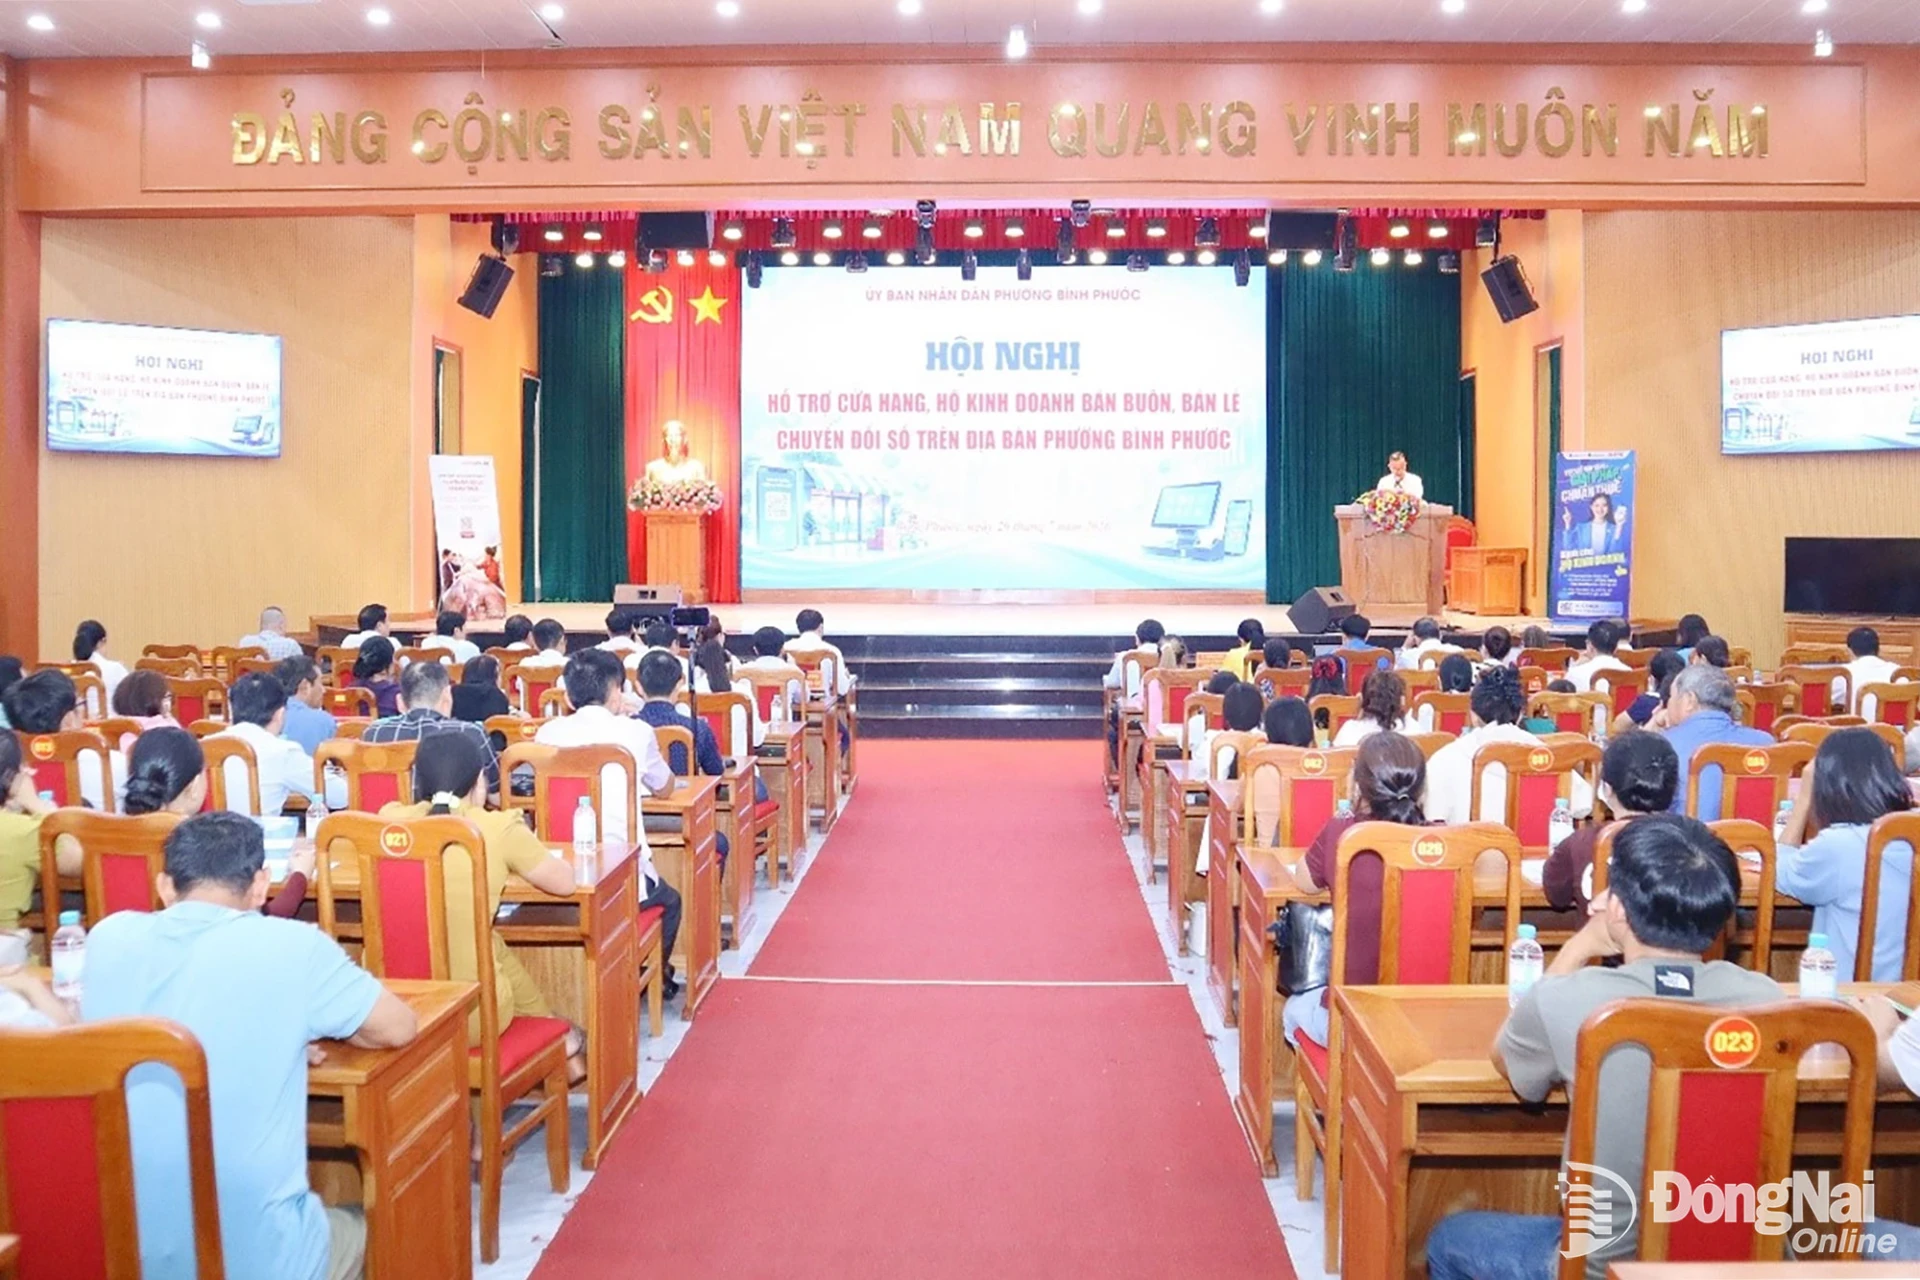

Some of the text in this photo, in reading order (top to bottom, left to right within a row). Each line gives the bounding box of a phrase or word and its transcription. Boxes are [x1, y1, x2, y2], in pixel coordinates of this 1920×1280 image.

[231, 85, 1769, 175] ĐẢNG CỘNG SẢN VIỆT NAM QUANG VINH MUÔN NĂM
[886, 289, 914, 301] BAN
[926, 336, 1080, 377] HỘI NGHỊ
[966, 392, 1009, 413] KINH
[1015, 392, 1075, 413] DOANH
[1713, 1030, 1755, 1054] 023
